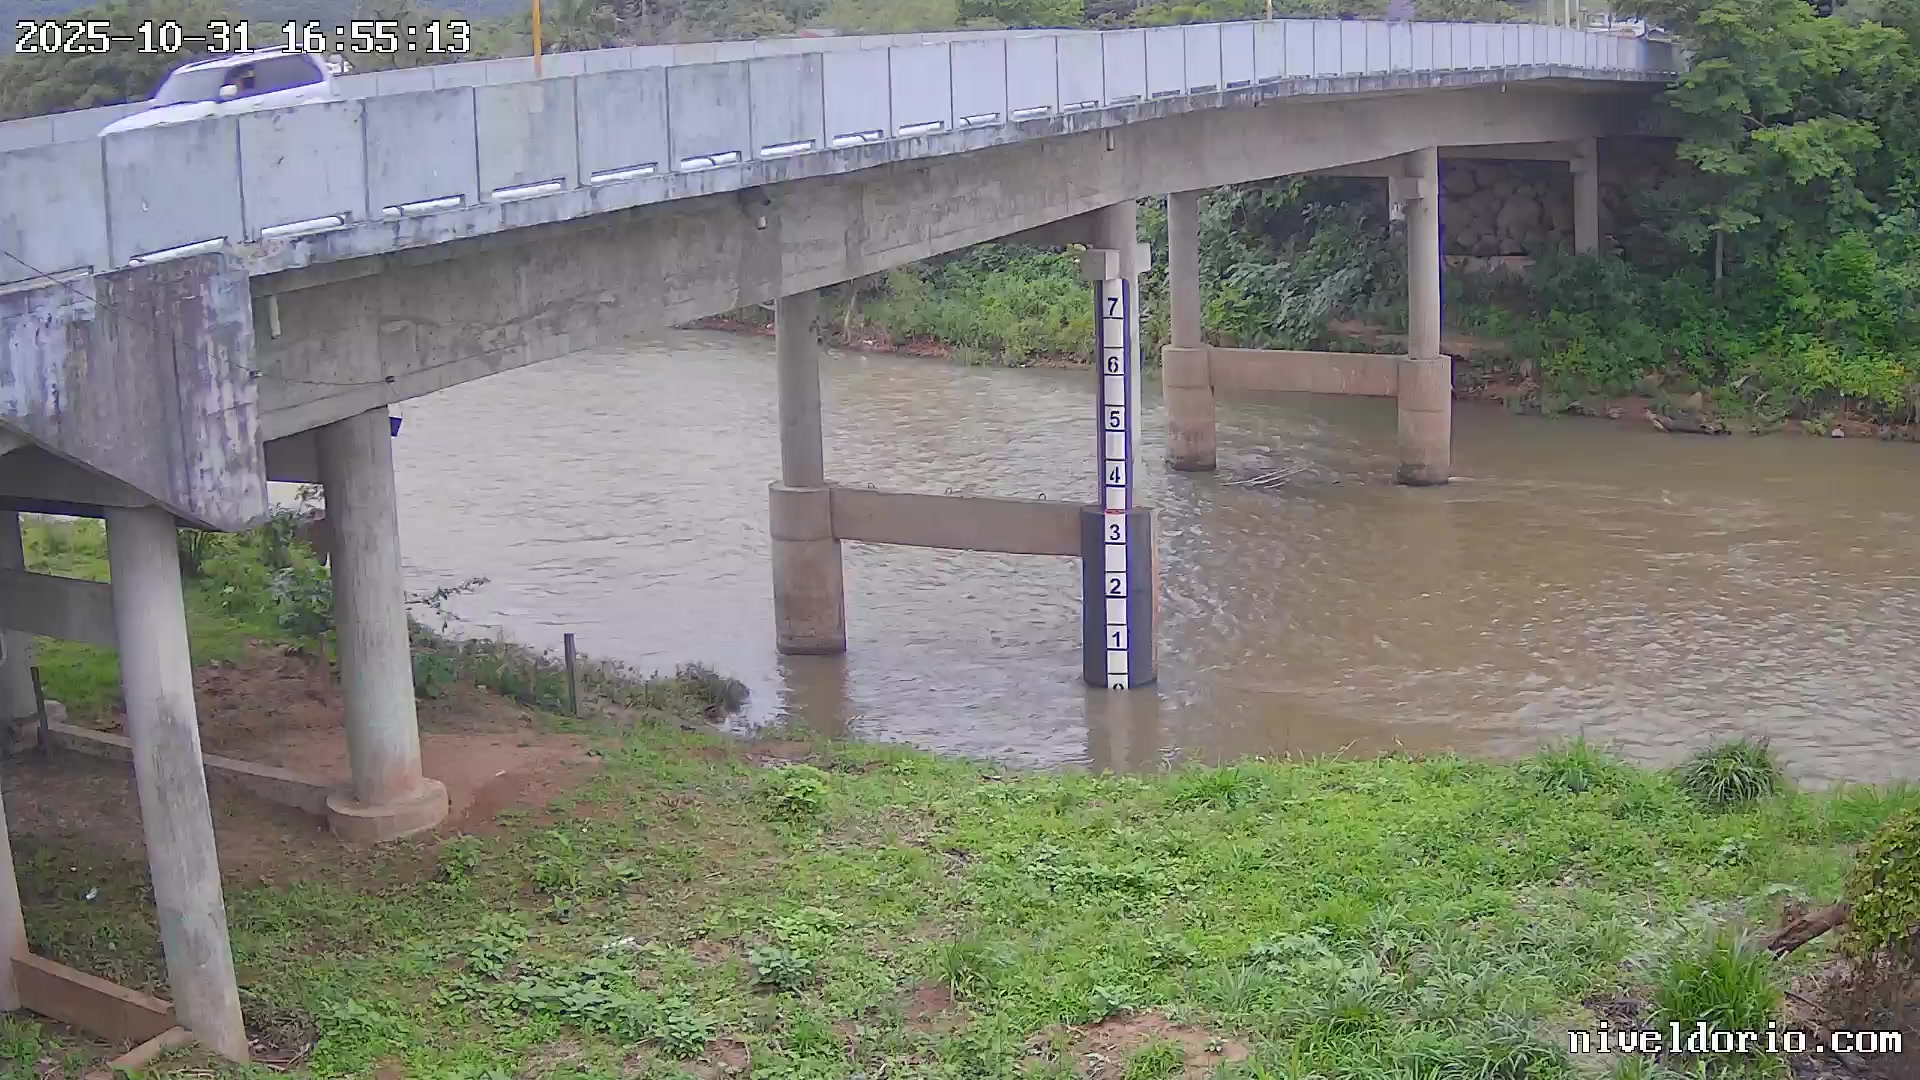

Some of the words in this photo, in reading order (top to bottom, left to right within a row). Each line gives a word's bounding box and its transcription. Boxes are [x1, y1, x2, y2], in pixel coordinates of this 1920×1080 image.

[1107, 297, 1119, 316] 7
[1107, 355, 1119, 373] 6
[1109, 410, 1121, 428] 5
[1109, 465, 1121, 484] 4
[1109, 523, 1121, 541] 3
[1109, 578, 1122, 595] 2
[1111, 631, 1121, 648] 1
